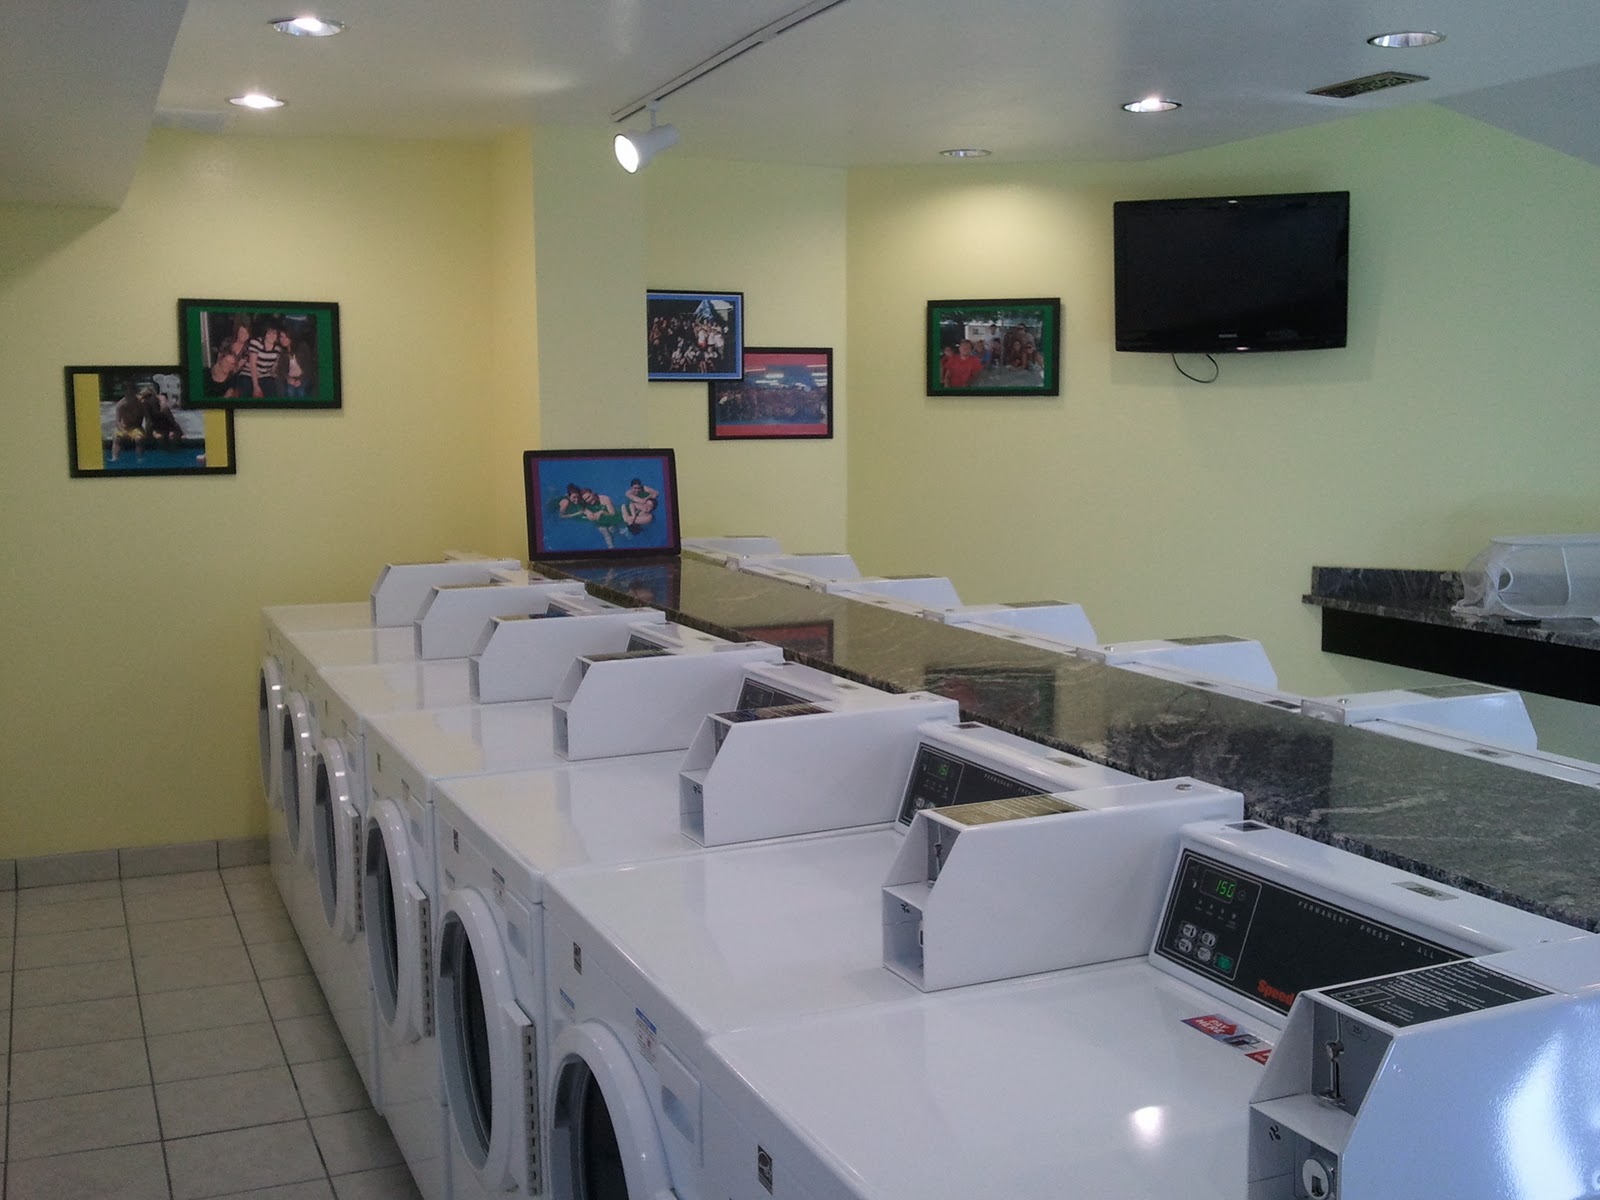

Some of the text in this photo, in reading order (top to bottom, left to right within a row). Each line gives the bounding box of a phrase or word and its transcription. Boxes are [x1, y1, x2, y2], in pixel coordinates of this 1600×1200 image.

[1216, 880, 1236, 898] 150
[1298, 900, 1350, 925] PERMANENT
[1360, 923, 1390, 941] PRESS
[1257, 979, 1295, 1006] Speed
